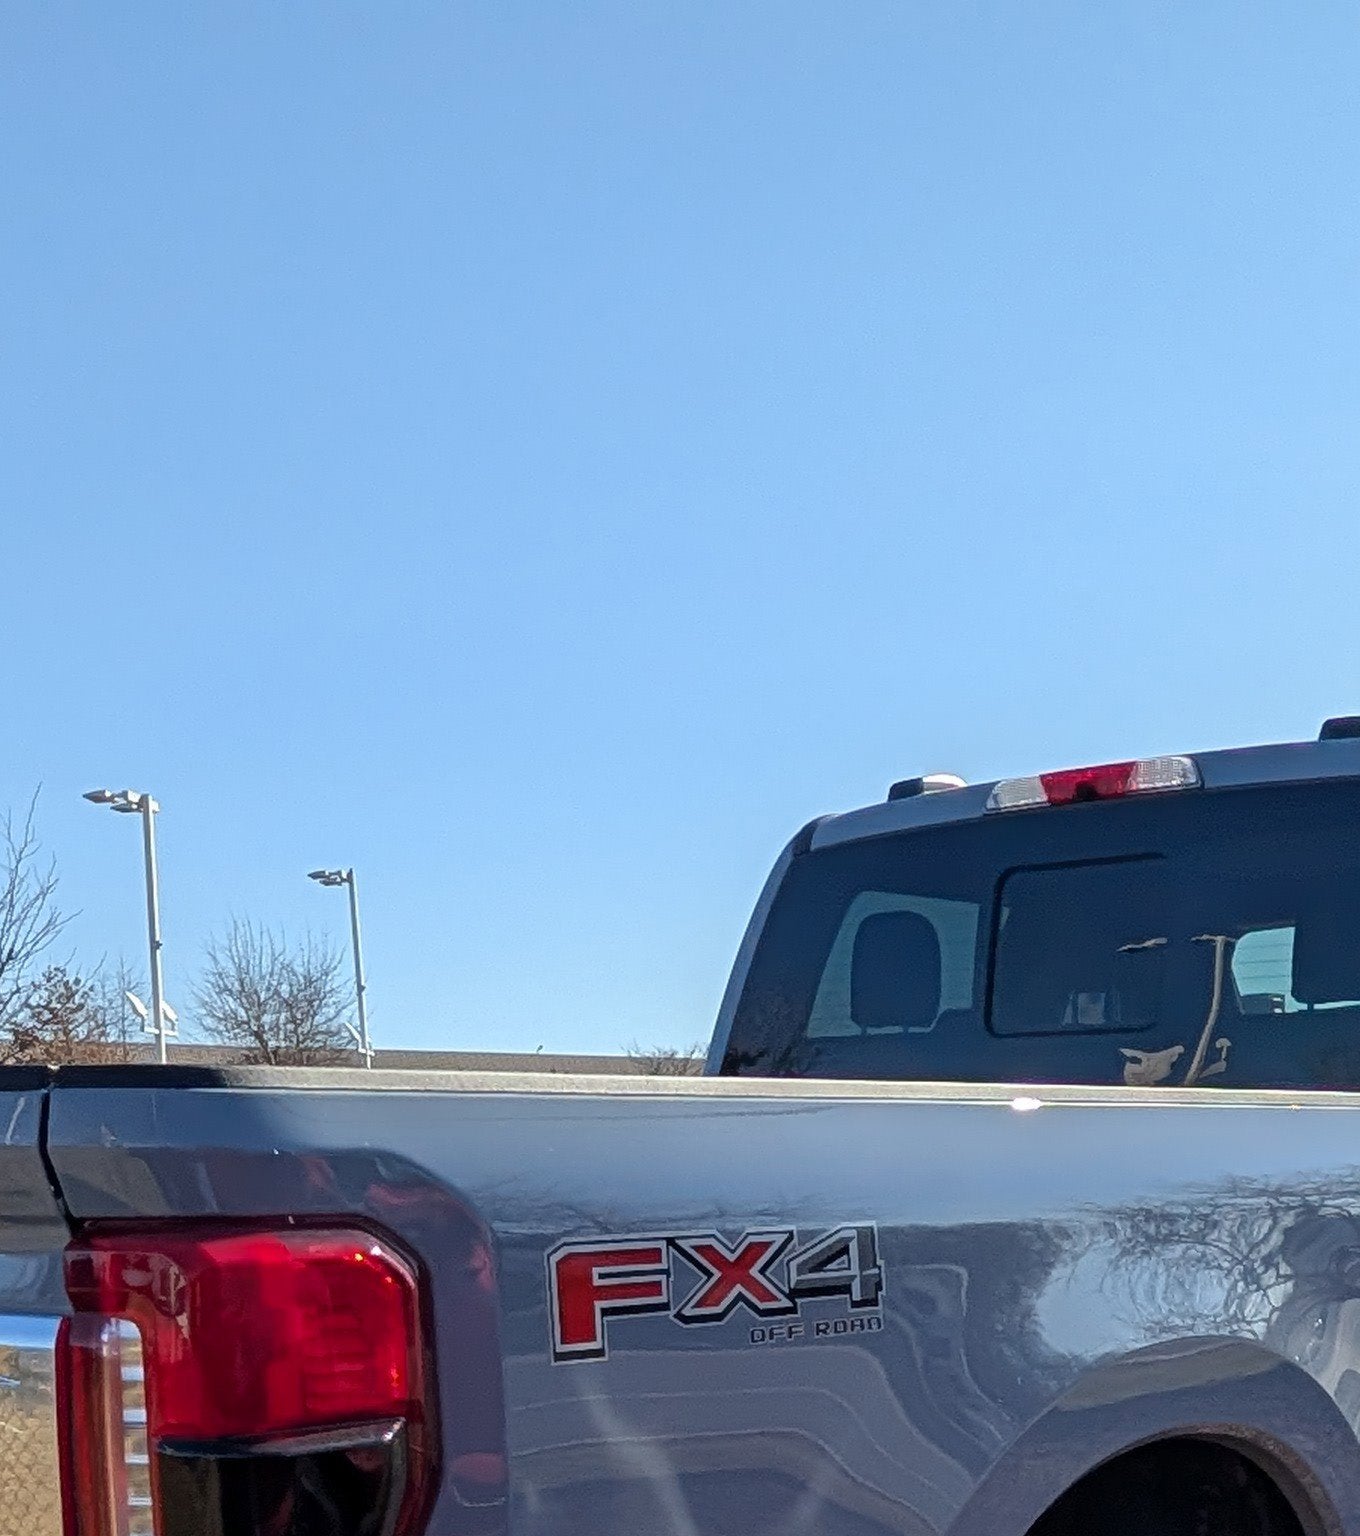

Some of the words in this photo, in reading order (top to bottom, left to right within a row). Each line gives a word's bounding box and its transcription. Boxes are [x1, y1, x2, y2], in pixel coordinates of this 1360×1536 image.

[546, 1221, 885, 1364] FX4
[749, 1322, 805, 1344] OFF
[813, 1314, 883, 1338] ROAD
